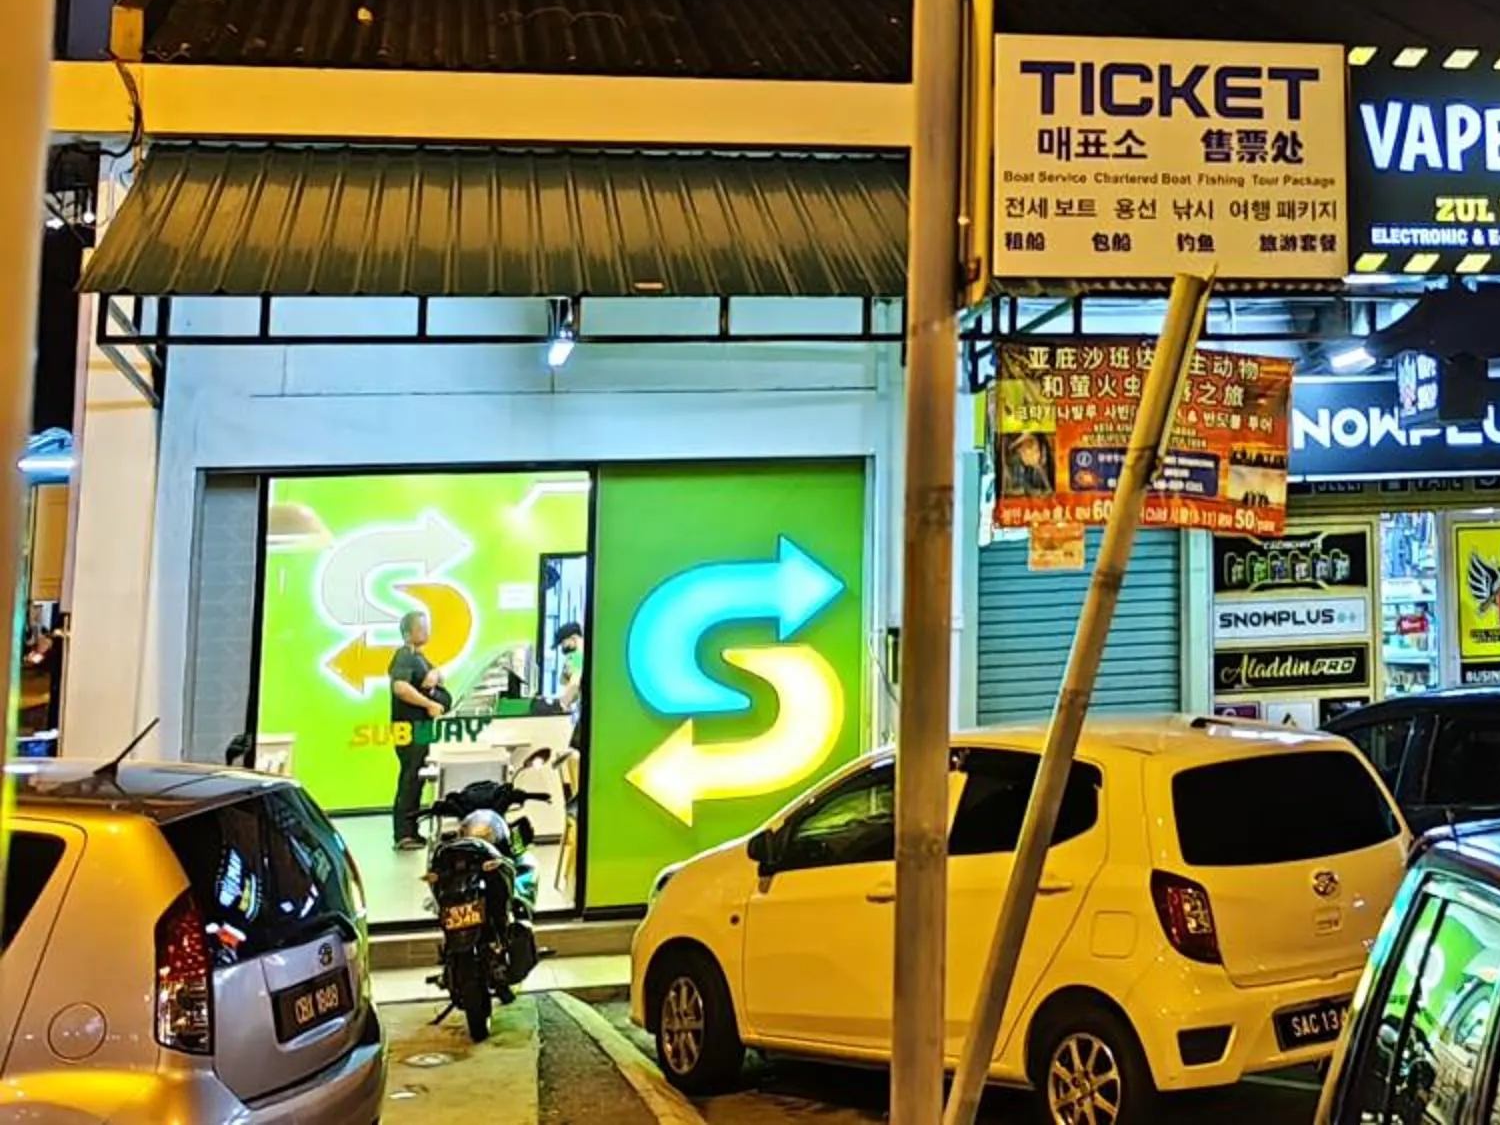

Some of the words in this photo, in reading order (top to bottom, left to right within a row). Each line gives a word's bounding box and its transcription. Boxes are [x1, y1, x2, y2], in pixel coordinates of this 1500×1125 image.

[1020, 60, 1320, 121] TICKET
[1038, 126, 1149, 162] 매표소
[1201, 129, 1304, 164] 售票处
[1003, 170, 1034, 183] Boat
[1038, 171, 1087, 184] Service
[1093, 172, 1158, 185] Chartered
[1161, 173, 1192, 185] Boat
[1197, 173, 1246, 188] Fishing
[1251, 174, 1279, 185] Tour
[1283, 175, 1335, 188] Package
[1004, 196, 1048, 220] 전세
[1055, 197, 1098, 218] 보트
[1113, 198, 1157, 220] 용선
[1172, 198, 1214, 220] 낚시
[1229, 199, 1271, 222] 여행
[1276, 200, 1337, 222] 패키지
[1435, 196, 1496, 223] ZUL
[1091, 231, 1132, 252] 包船
[1176, 232, 1215, 253] 钓鱼
[1259, 233, 1337, 253] 旅游套餐
[1371, 227, 1468, 245] ELECTRONIC
[1472, 229, 1485, 246] &
[1219, 608, 1335, 629] SNOWPLUS
[1291, 1013, 1320, 1038] SAC
